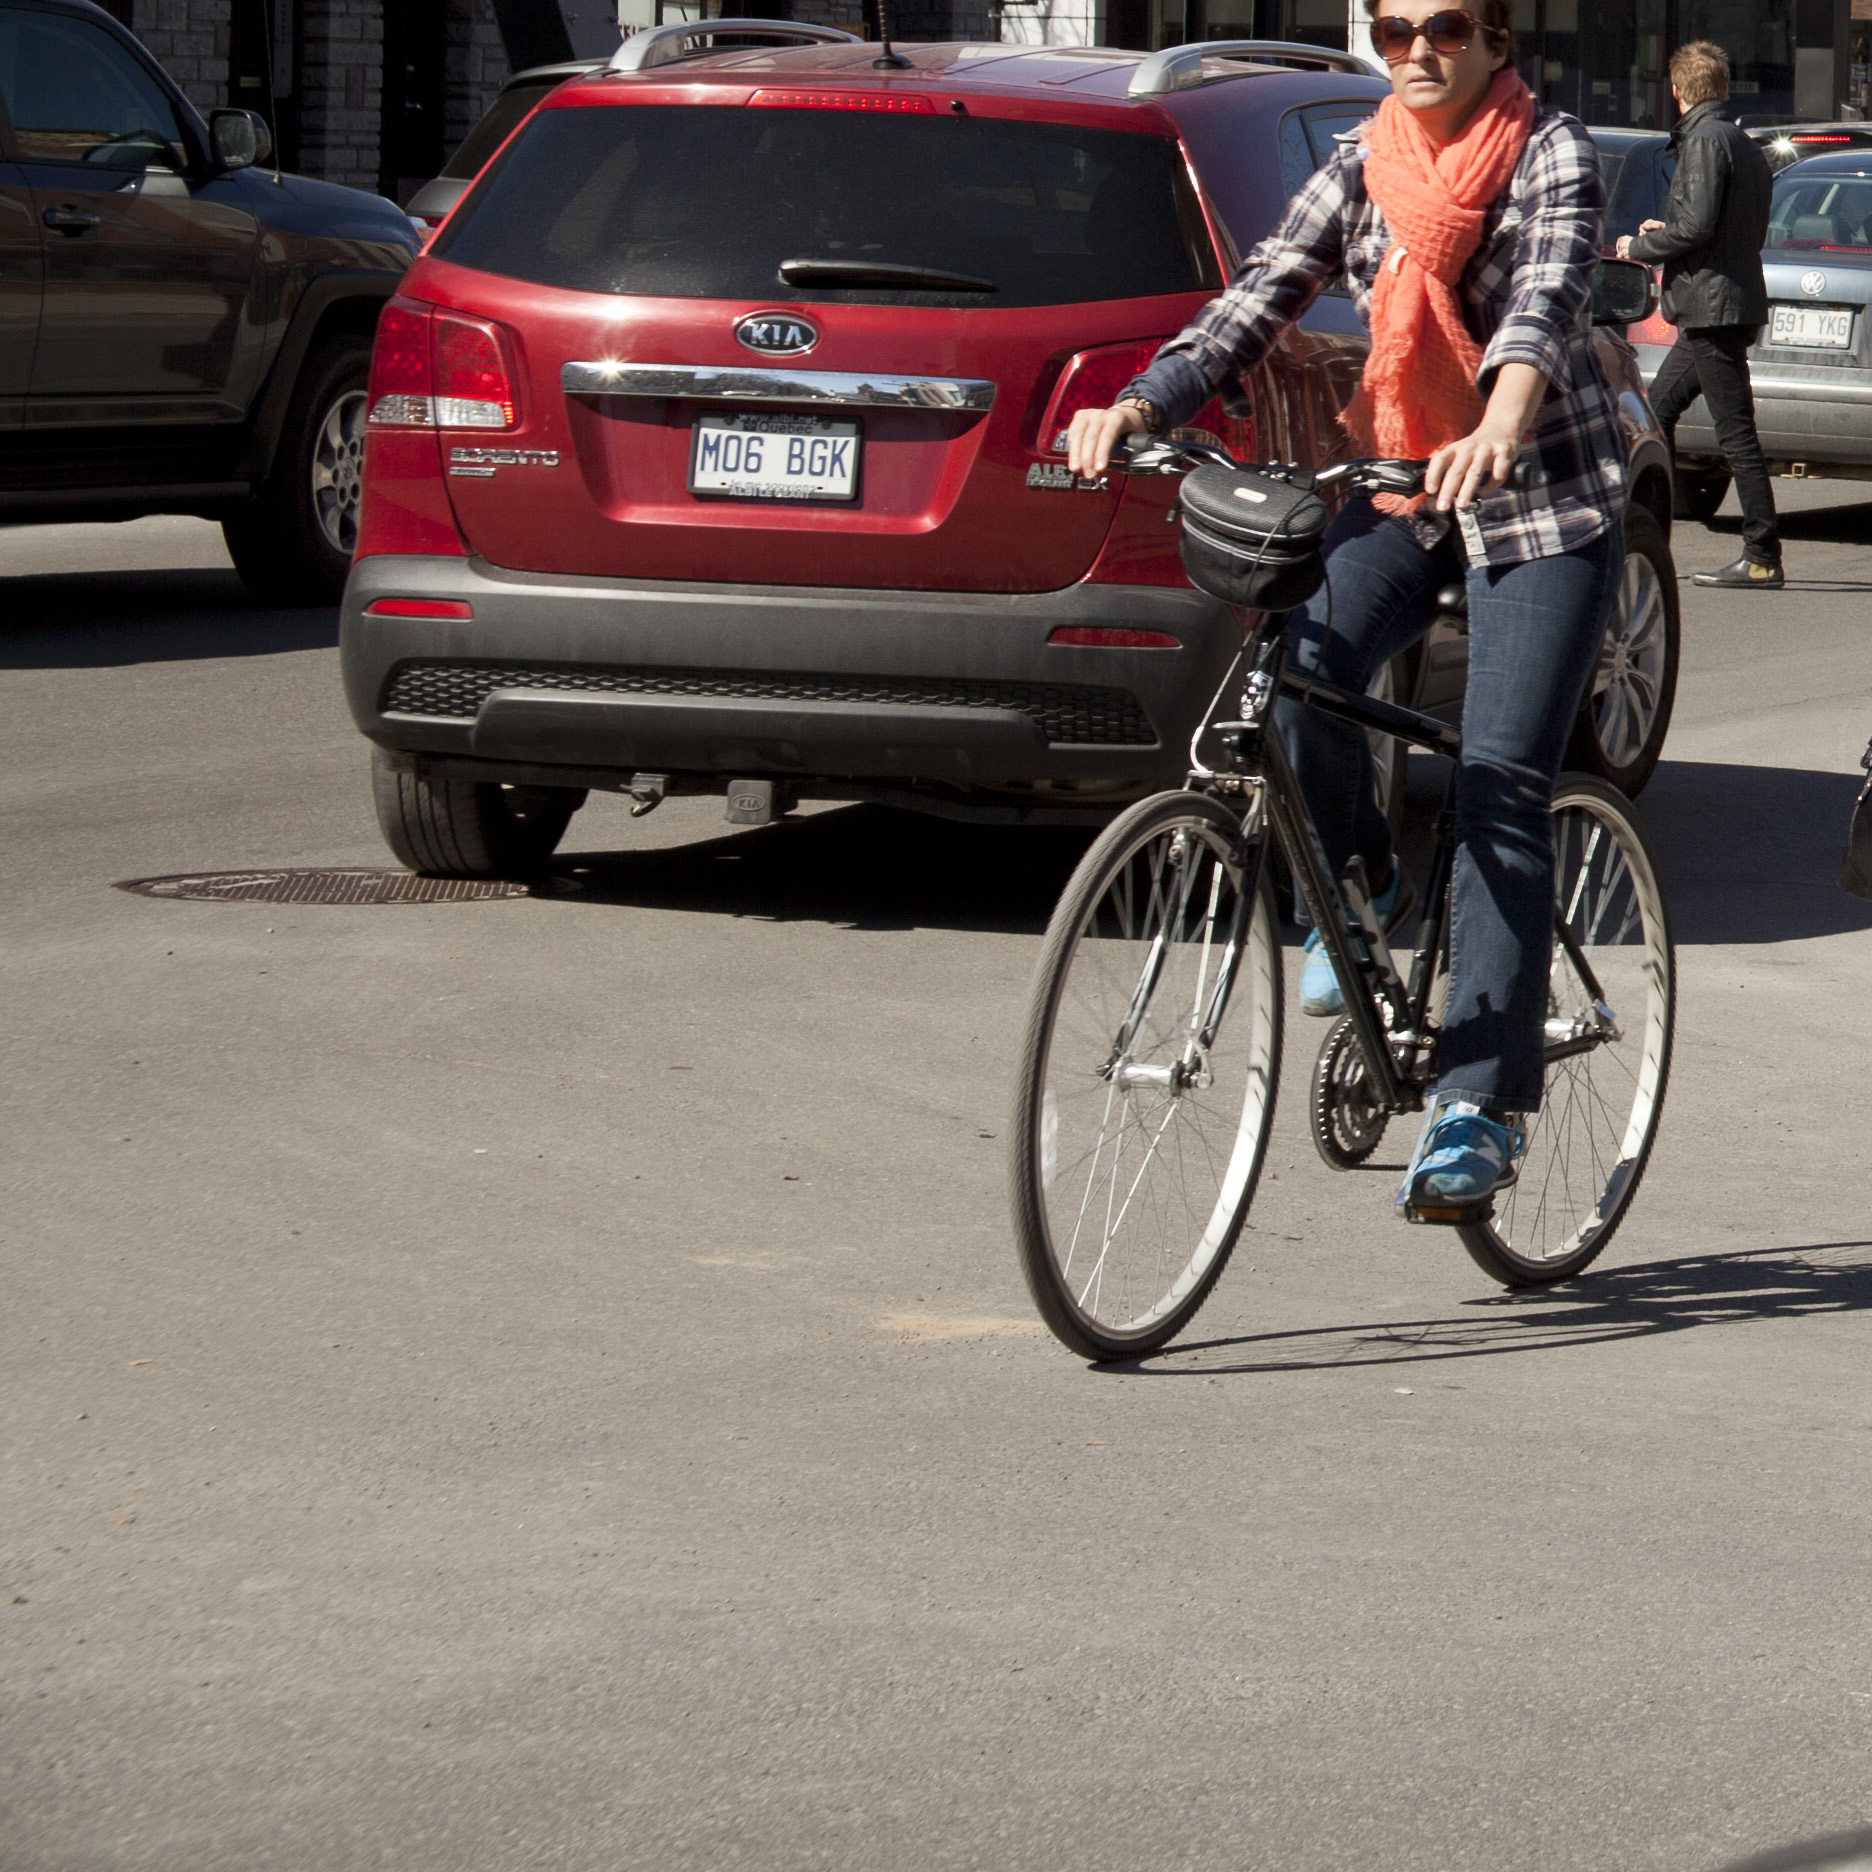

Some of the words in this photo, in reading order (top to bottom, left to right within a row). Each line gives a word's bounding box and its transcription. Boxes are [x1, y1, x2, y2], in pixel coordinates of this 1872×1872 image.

[750, 323, 804, 346] KIA
[1775, 312, 1805, 333] 591
[1818, 314, 1848, 336] YKG
[450, 447, 560, 467] SORENTO
[700, 433, 764, 474] M06
[786, 436, 850, 478] BGK
[1077, 476, 1108, 490] EX
